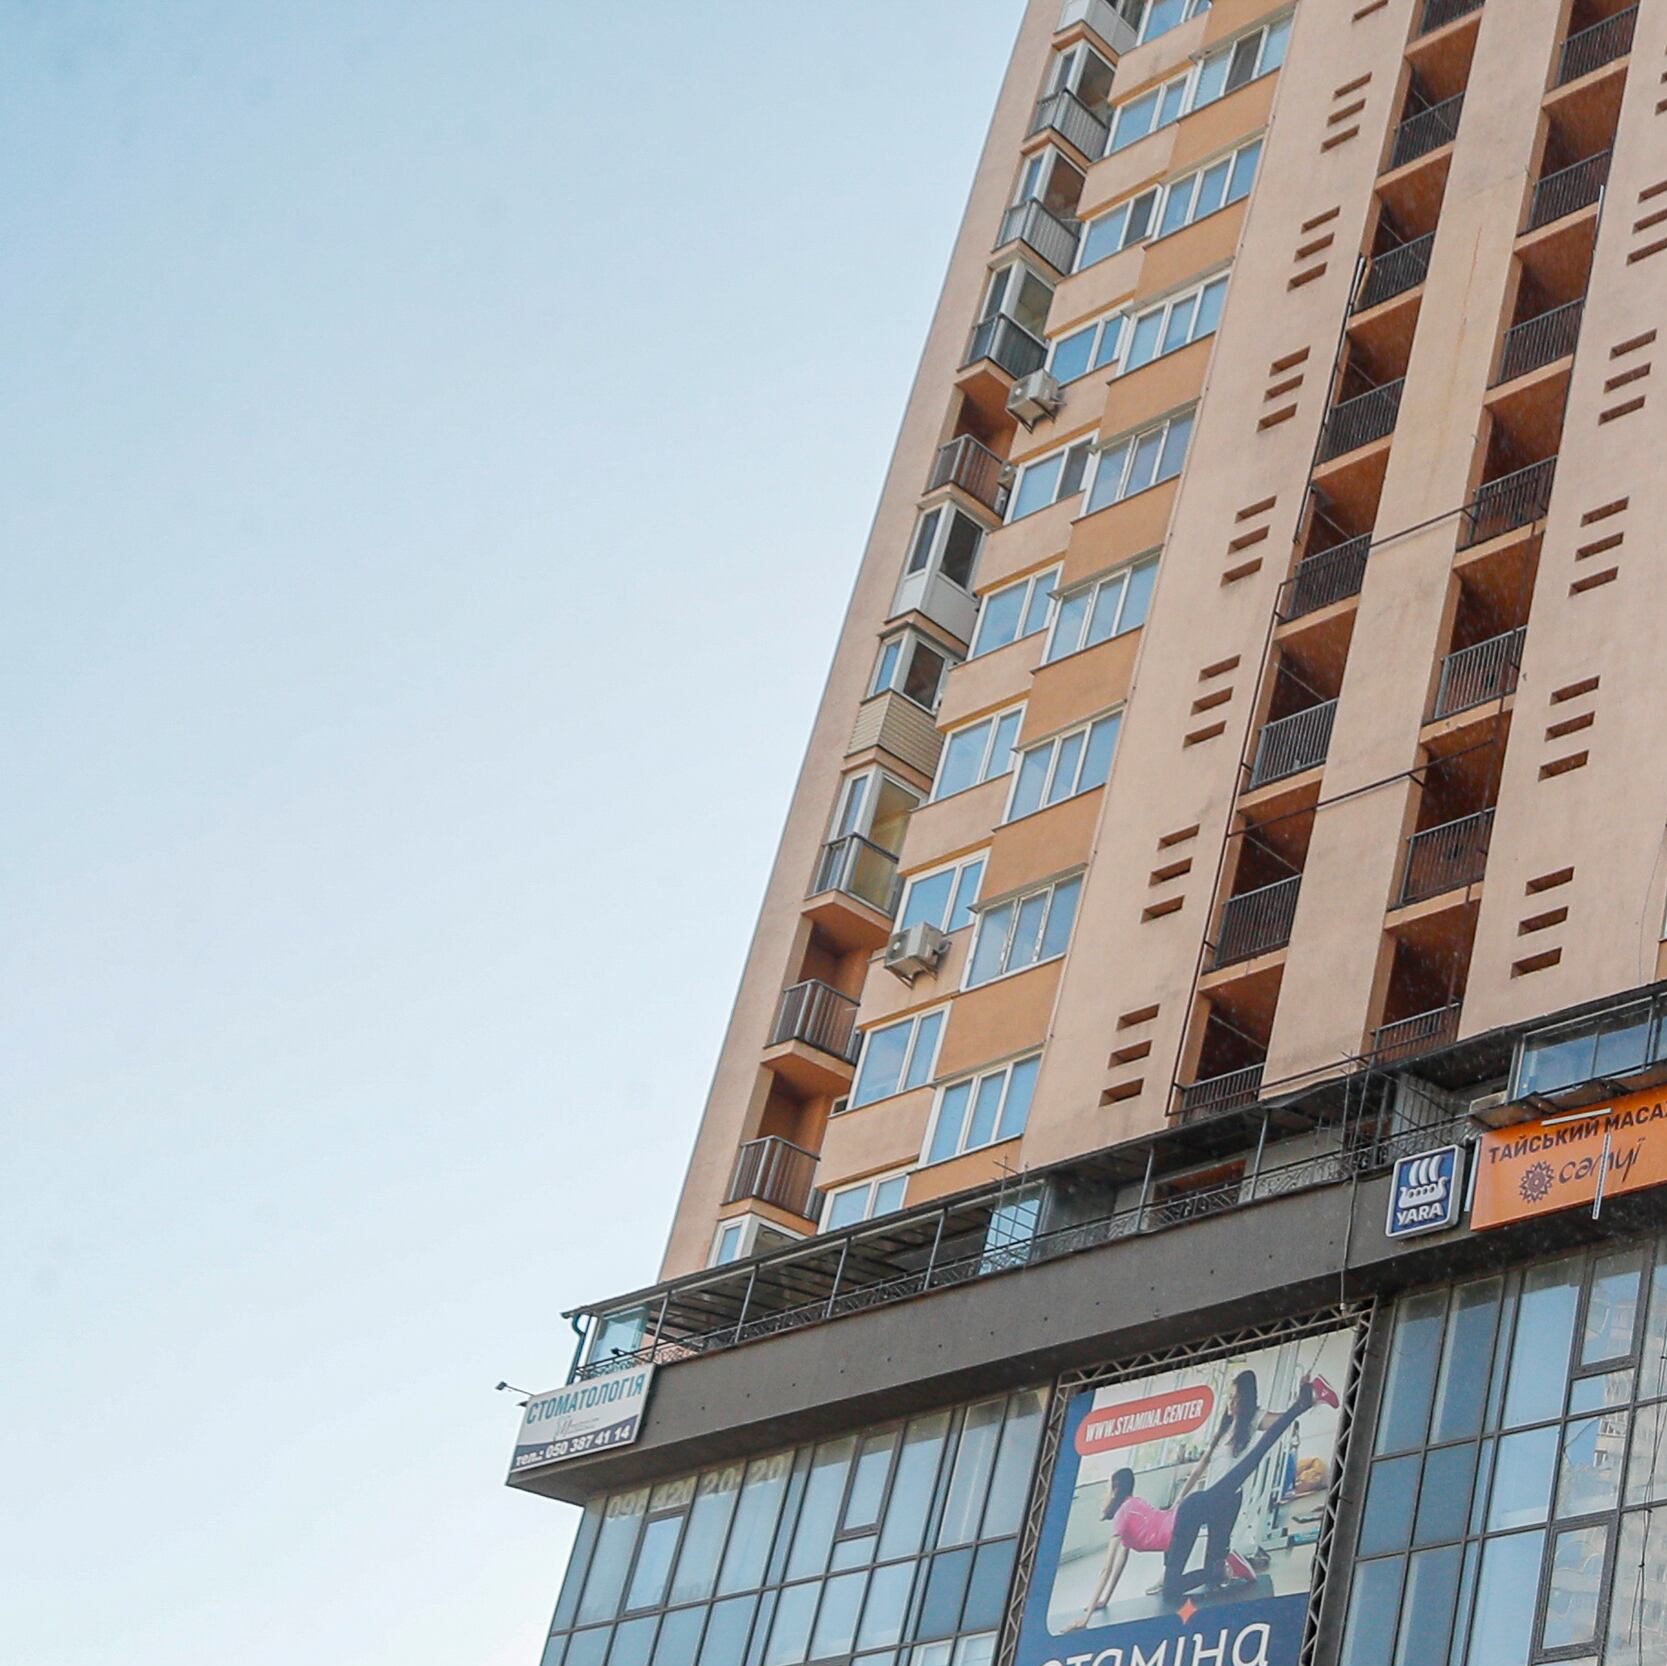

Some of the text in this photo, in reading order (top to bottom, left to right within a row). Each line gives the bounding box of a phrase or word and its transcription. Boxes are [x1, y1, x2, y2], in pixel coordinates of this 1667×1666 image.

[1488, 1116, 1599, 1165] ТАЙСЬКИЙ
[1396, 1203, 1444, 1226] YARA
[526, 1373, 646, 1425] СТОМАТОЛОГІЯ
[1085, 1399, 1204, 1442] WWW.STAMINA.CENTER
[546, 1441, 567, 1458] 050
[570, 1433, 594, 1452] 387
[594, 1430, 611, 1447] 41
[614, 1424, 631, 1441] 14
